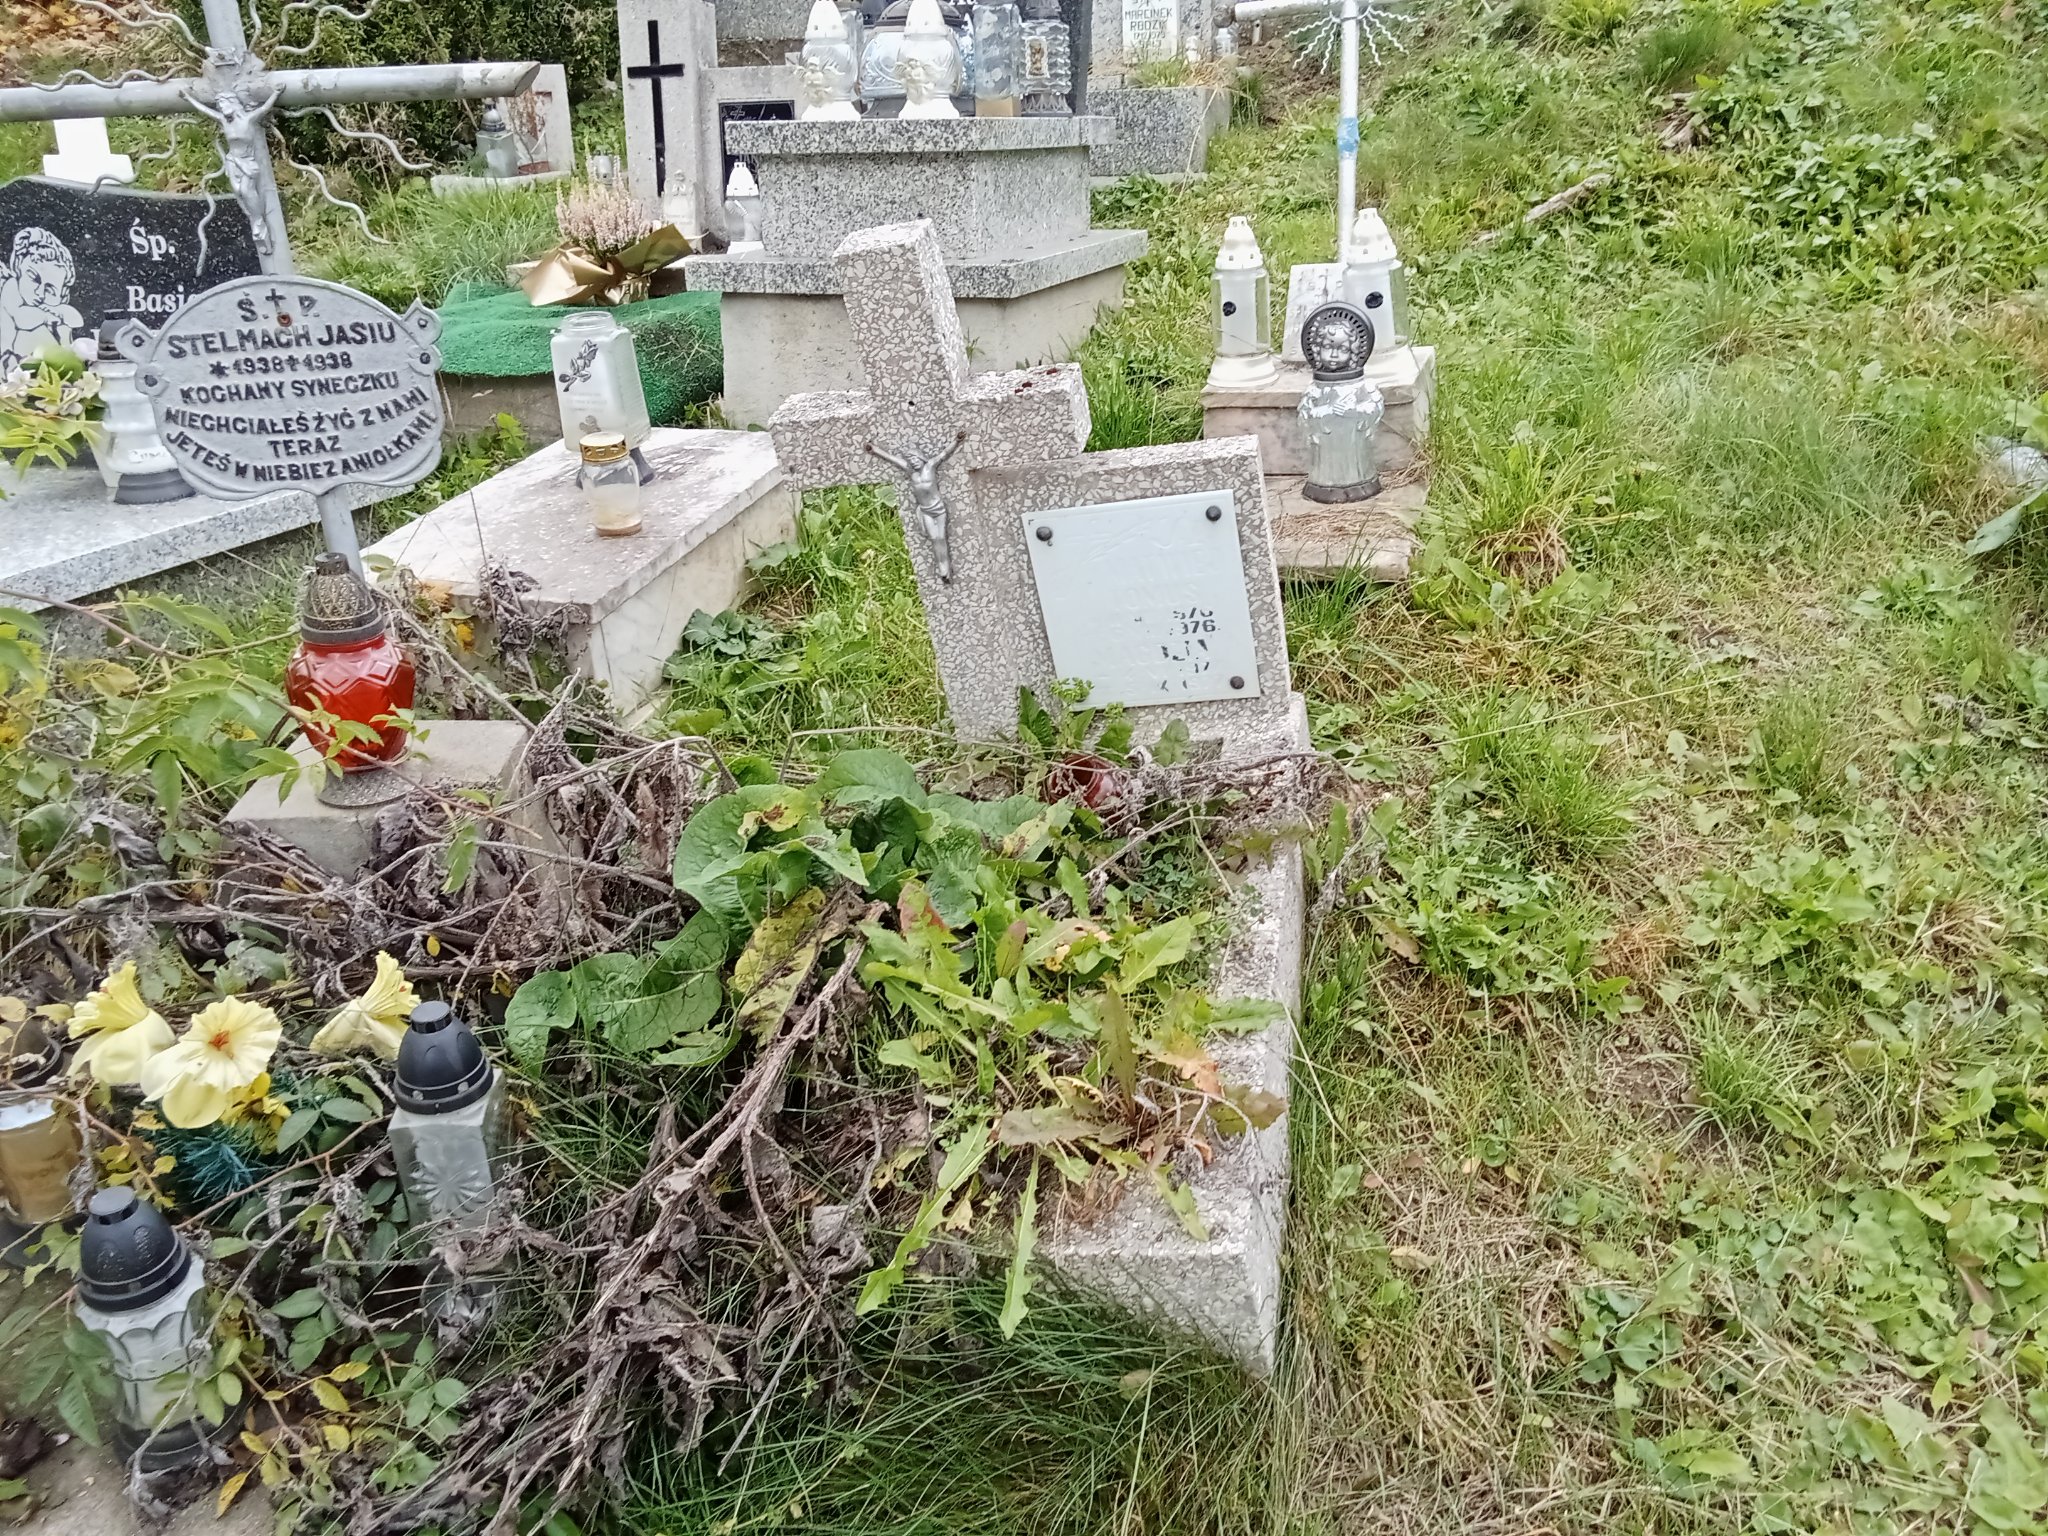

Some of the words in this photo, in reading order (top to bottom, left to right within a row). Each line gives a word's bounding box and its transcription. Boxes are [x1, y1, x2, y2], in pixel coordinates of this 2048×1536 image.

[1124, 7, 1172, 20] MARCINEK
[129, 217, 176, 261] Śp.
[168, 324, 312, 359] STELMACH
[317, 321, 396, 347] JASIU
[180, 380, 285, 404] KOCHANY
[291, 371, 399, 397] SYNECZKU
[358, 408, 376, 426] Z
[375, 386, 430, 422] NAMI
[166, 431, 231, 472] JETEŚ
[235, 461, 249, 479] W
[267, 435, 342, 458] TERAZ
